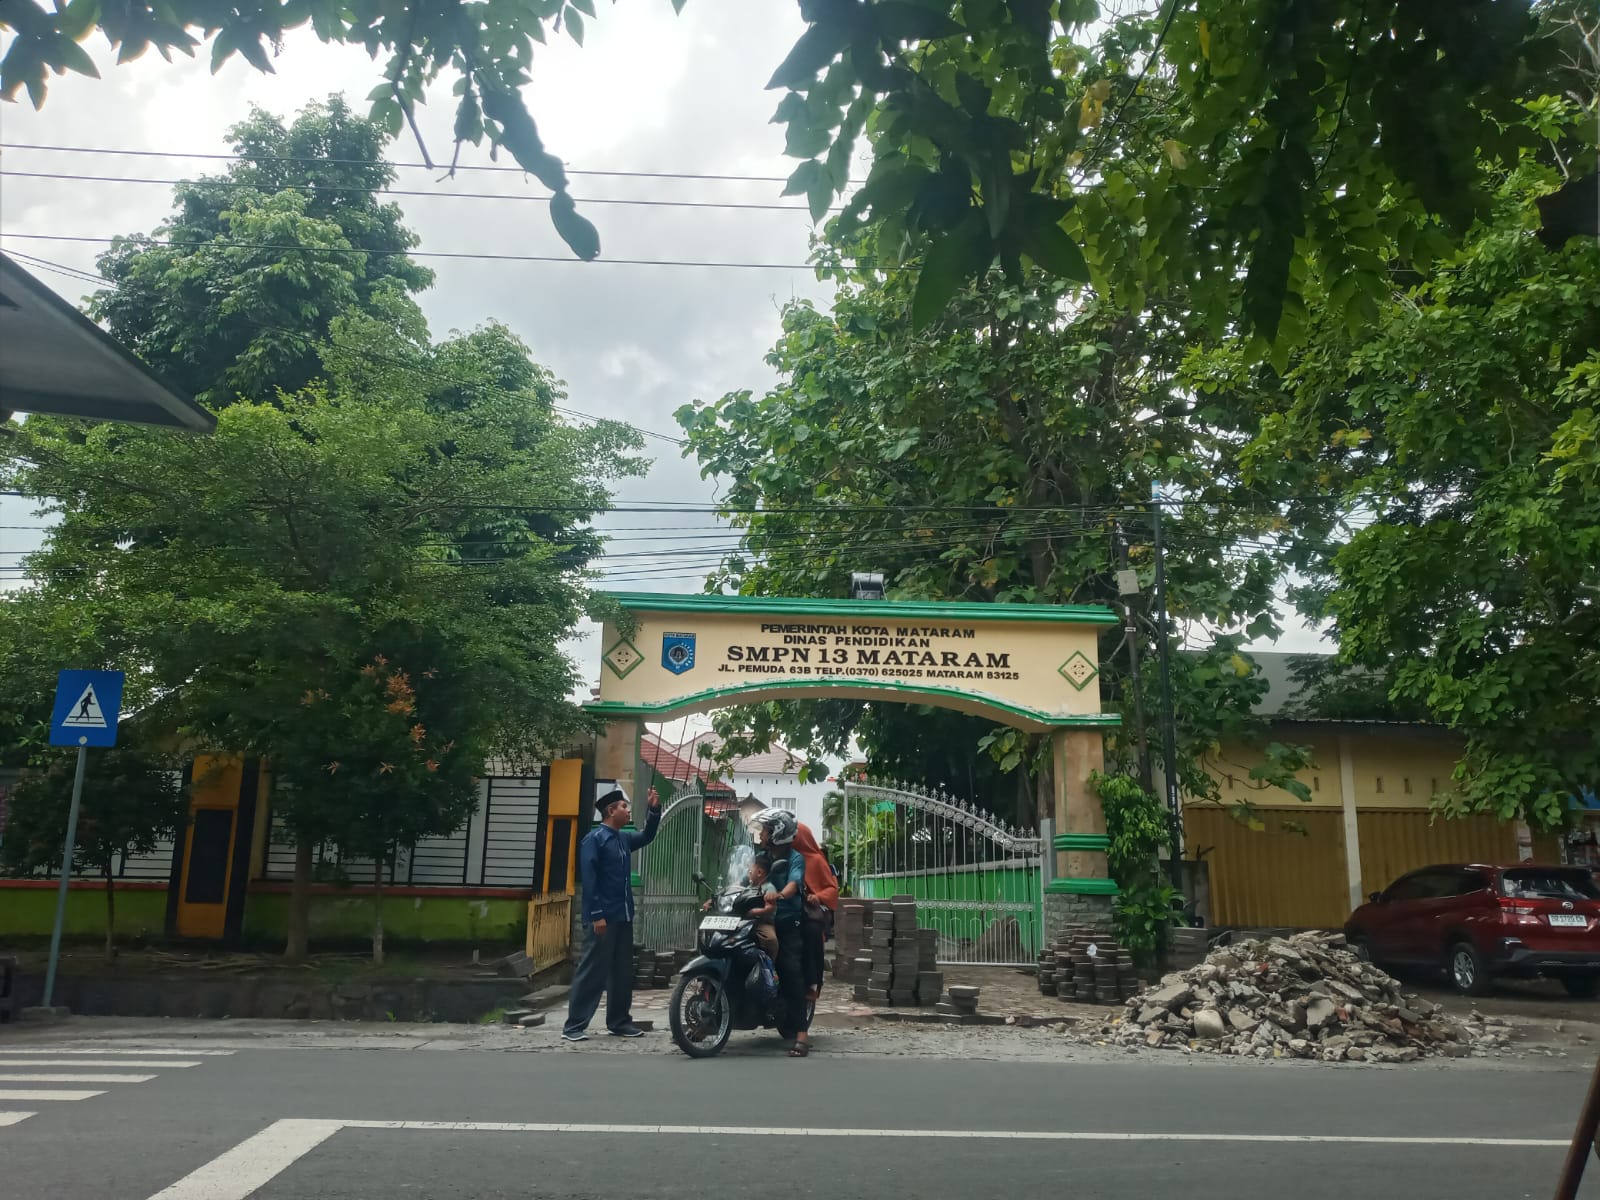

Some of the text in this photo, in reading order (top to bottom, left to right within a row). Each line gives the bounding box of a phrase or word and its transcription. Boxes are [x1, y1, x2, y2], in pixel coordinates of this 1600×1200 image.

[761, 624, 975, 638] PEMERINTAH KOTA MATARAM
[784, 635, 930, 647] DINAS PENDIDIKAN
[727, 645, 1011, 668] SMPN 13 MATARAM
[718, 664, 735, 672] JL.
[738, 665, 785, 674] PEMUDA
[790, 666, 811, 674] 63B
[881, 668, 923, 677] 625025
[926, 669, 984, 679] MATARAM
[986, 672, 1019, 680] 83125
